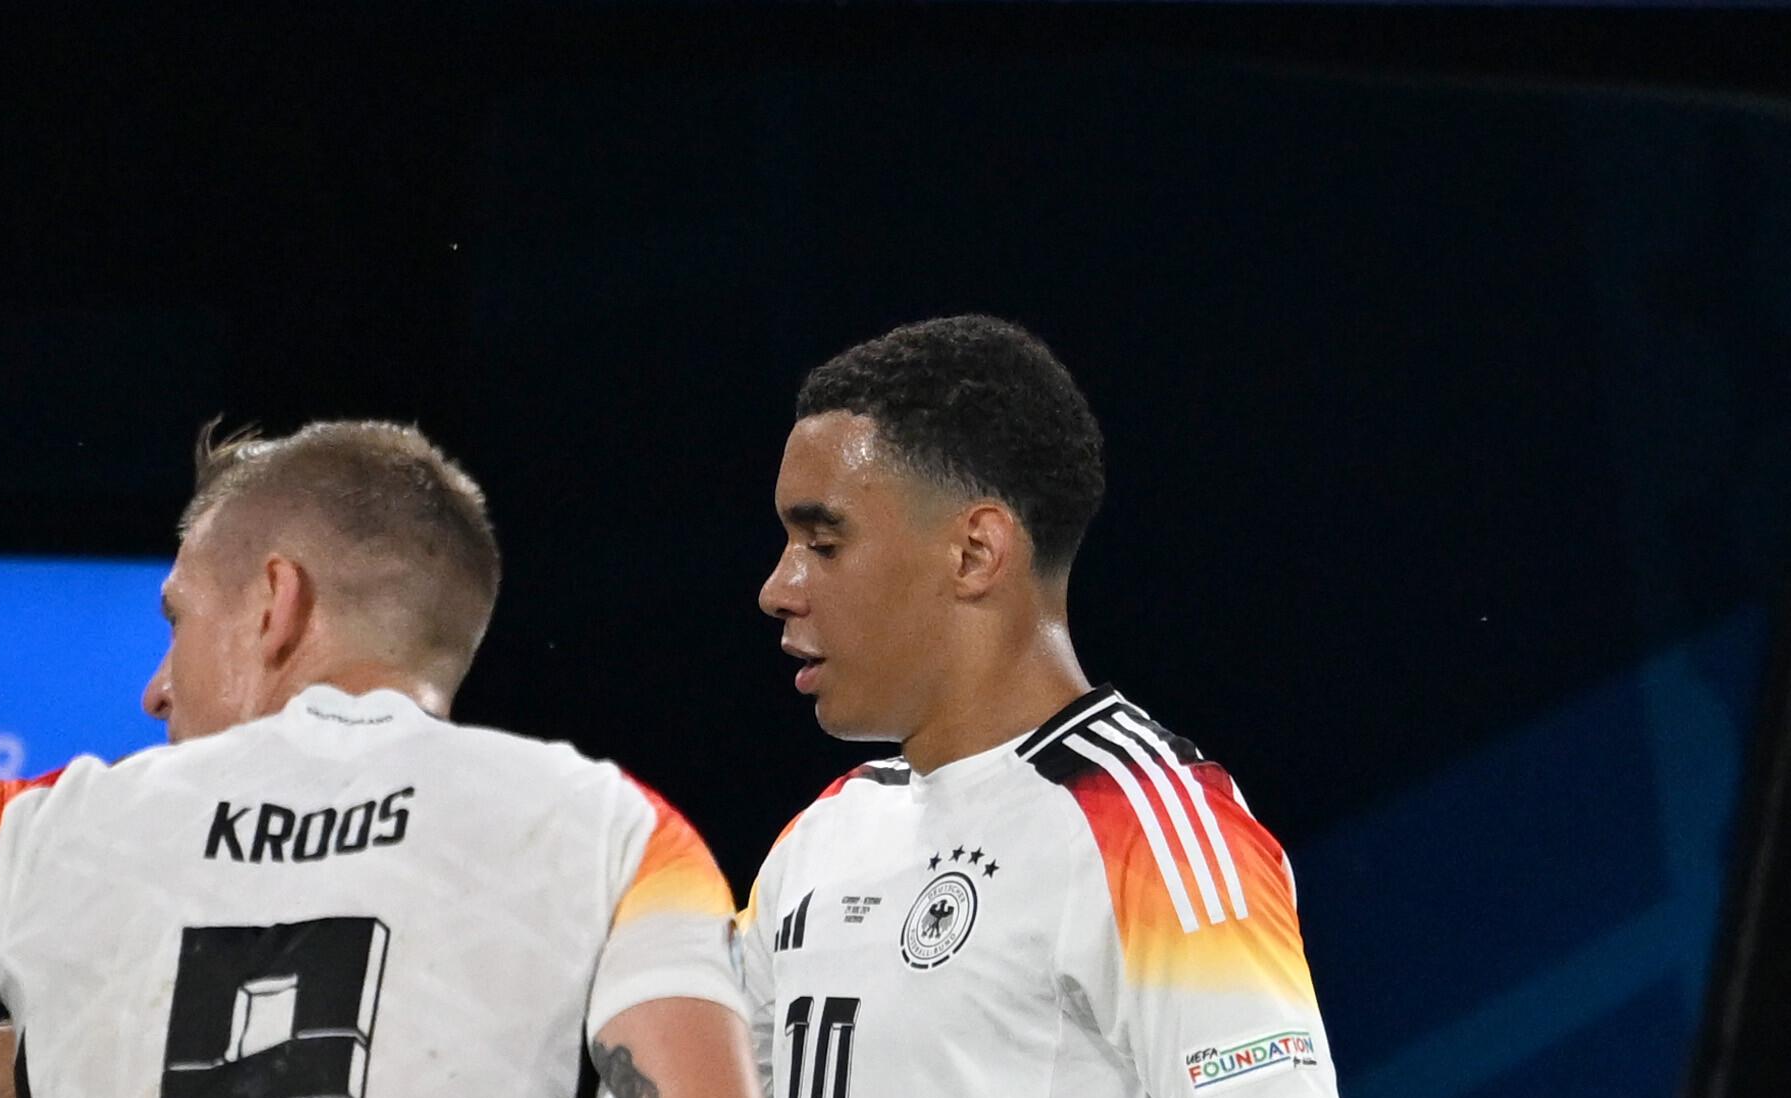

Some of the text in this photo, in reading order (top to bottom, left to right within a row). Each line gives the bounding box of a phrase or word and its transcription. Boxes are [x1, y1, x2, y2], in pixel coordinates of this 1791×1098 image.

[204, 786, 415, 864] KROOS
[1186, 1047, 1219, 1066] UEFA
[1188, 1036, 1314, 1083] FOUNDATION
